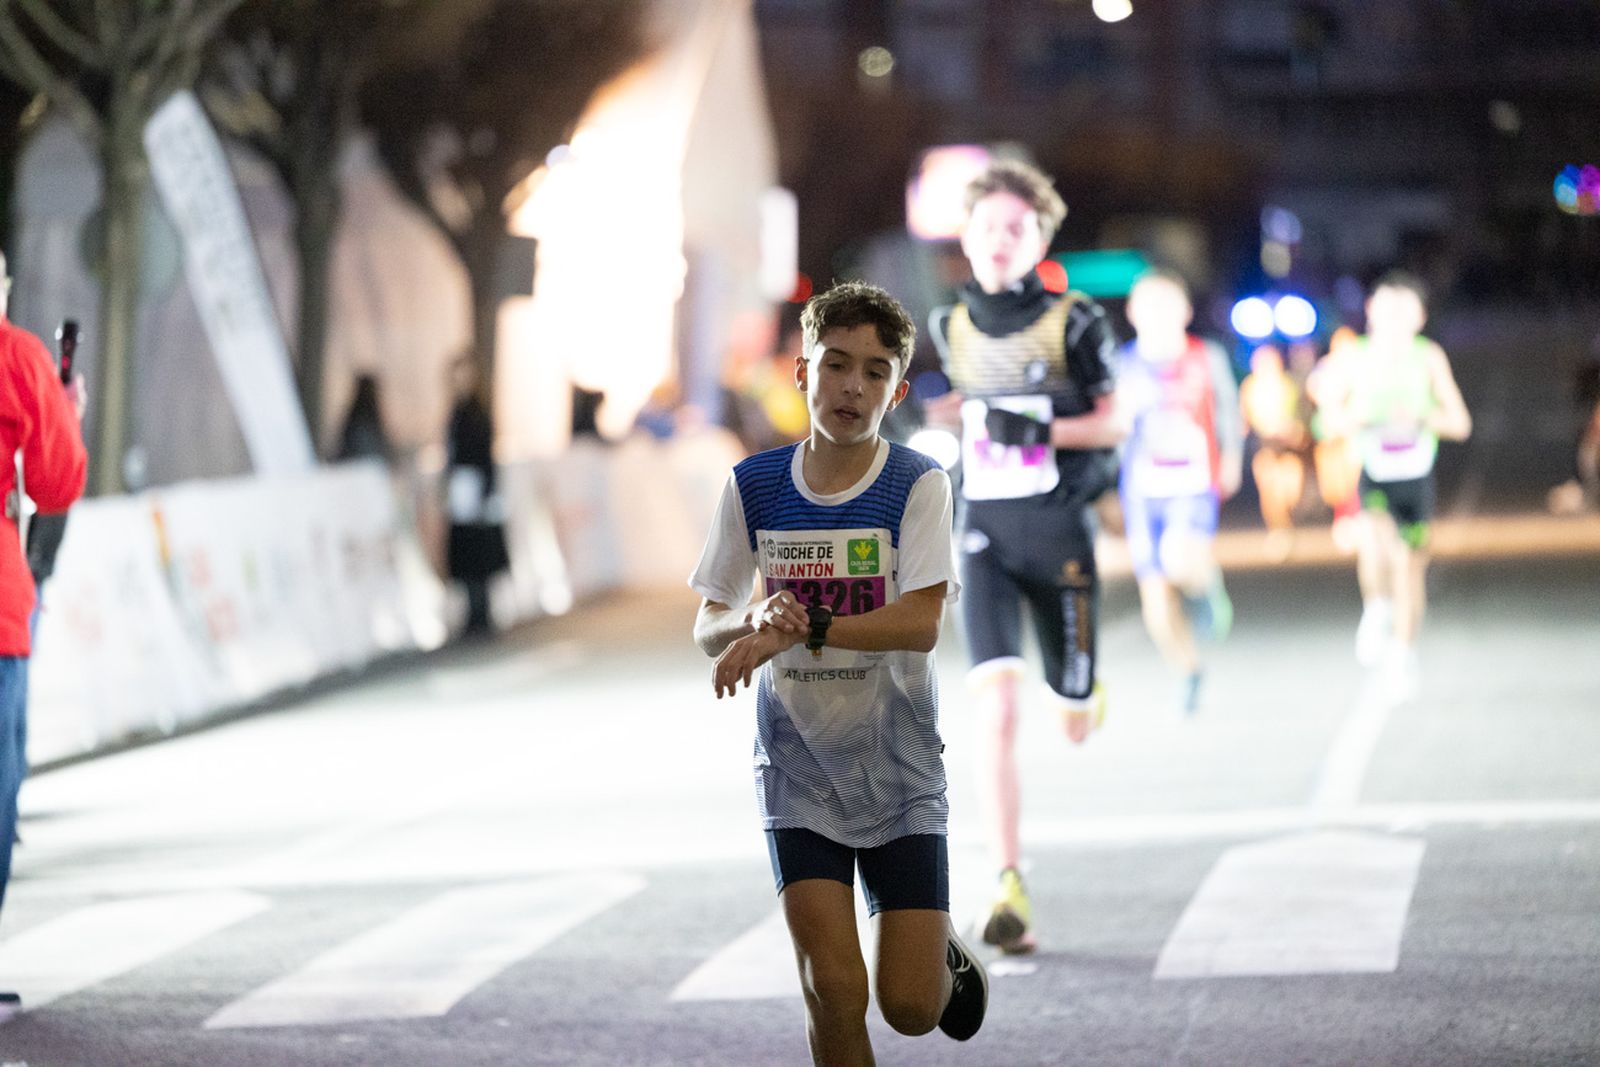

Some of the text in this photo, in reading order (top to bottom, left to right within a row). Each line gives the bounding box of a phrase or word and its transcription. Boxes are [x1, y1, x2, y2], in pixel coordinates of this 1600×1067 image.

[777, 546, 833, 560] NOCHE DE
[769, 560, 834, 577] SAN ANTÓN
[838, 670, 866, 680] CLUB
